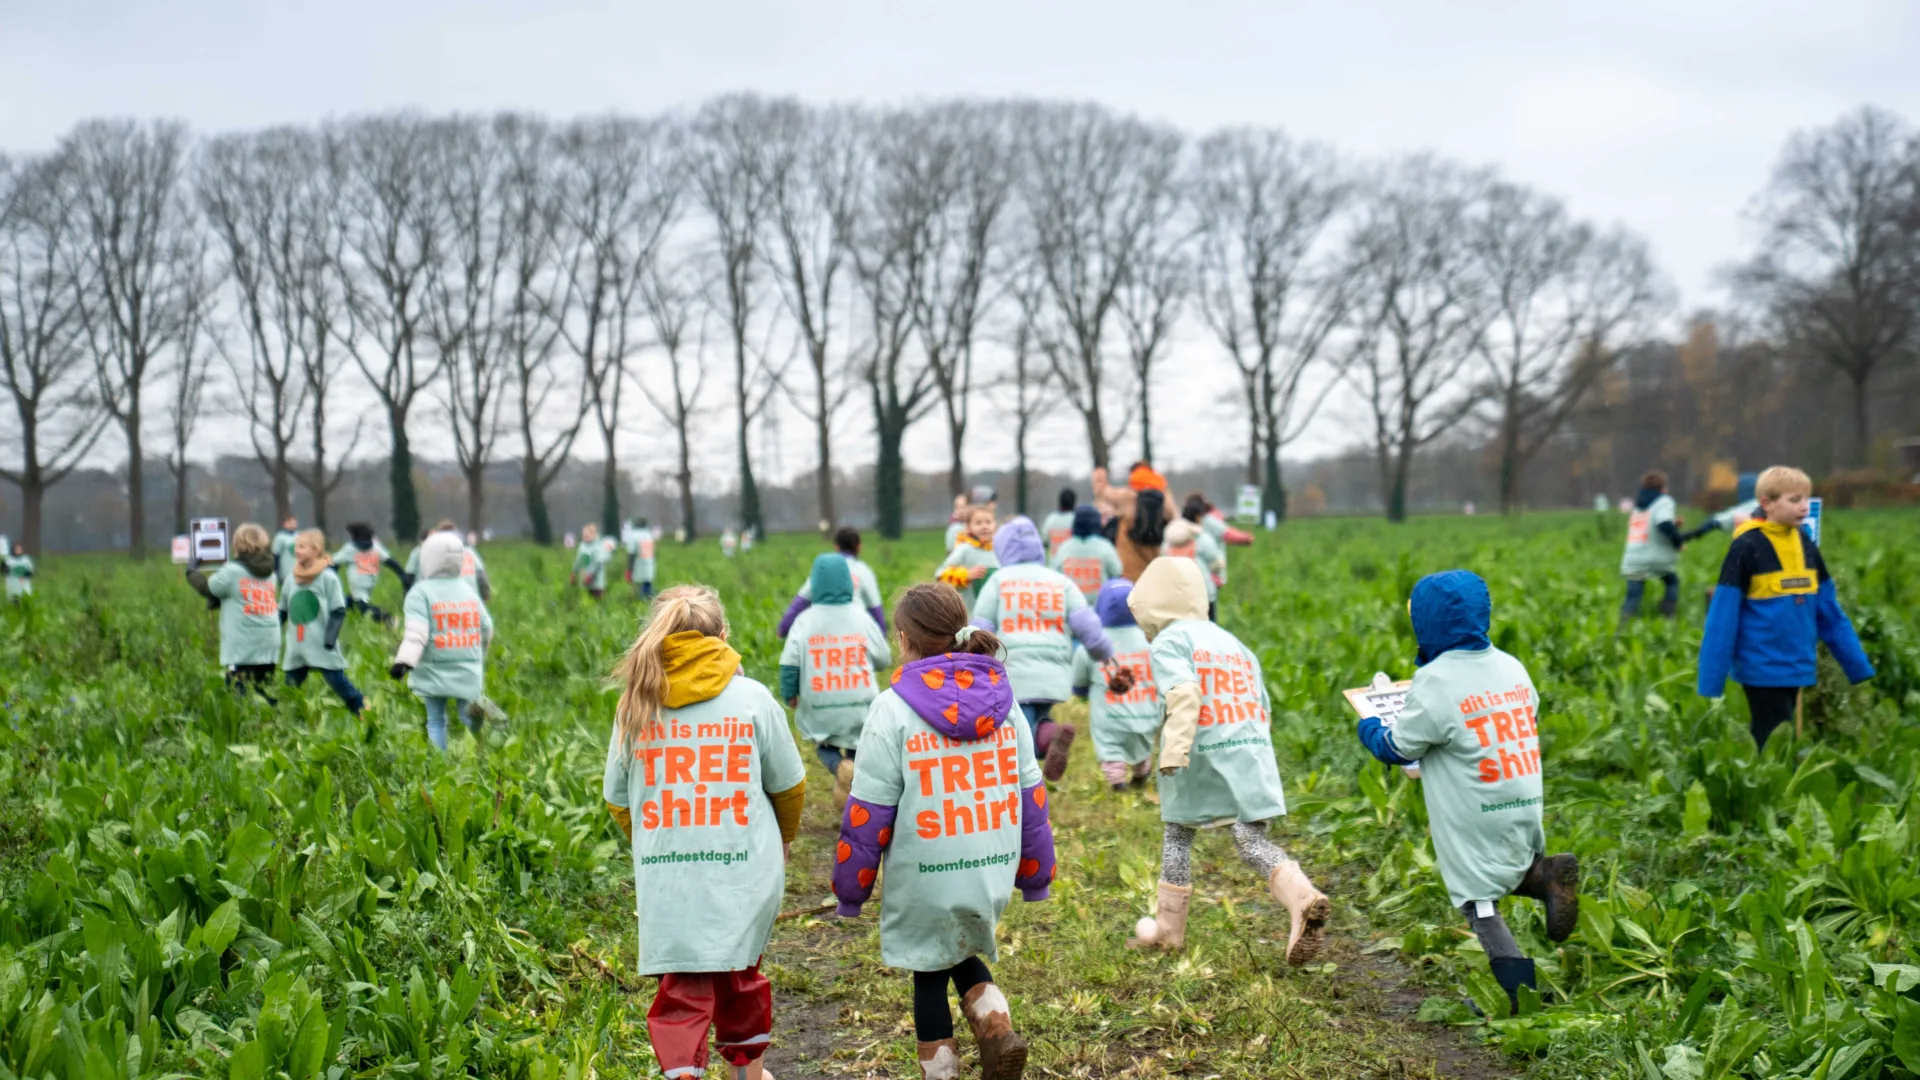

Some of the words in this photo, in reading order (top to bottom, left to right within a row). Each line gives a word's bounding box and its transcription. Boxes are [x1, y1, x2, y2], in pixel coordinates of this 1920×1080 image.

[1001, 591, 1064, 611] TREE
[432, 612, 481, 631] TREE
[1001, 611, 1064, 635] shirt
[434, 631, 481, 649] shirt
[808, 646, 867, 669] TREE
[811, 667, 871, 693] shirt
[1460, 696, 1487, 715] dit
[1485, 690, 1503, 707] is
[671, 718, 692, 739] is
[697, 717, 754, 744] mijn
[905, 731, 940, 754] dit
[634, 744, 753, 787] TREE
[908, 747, 1019, 797] TREE
[641, 783, 749, 830] shirt
[916, 790, 1019, 840] shirt
